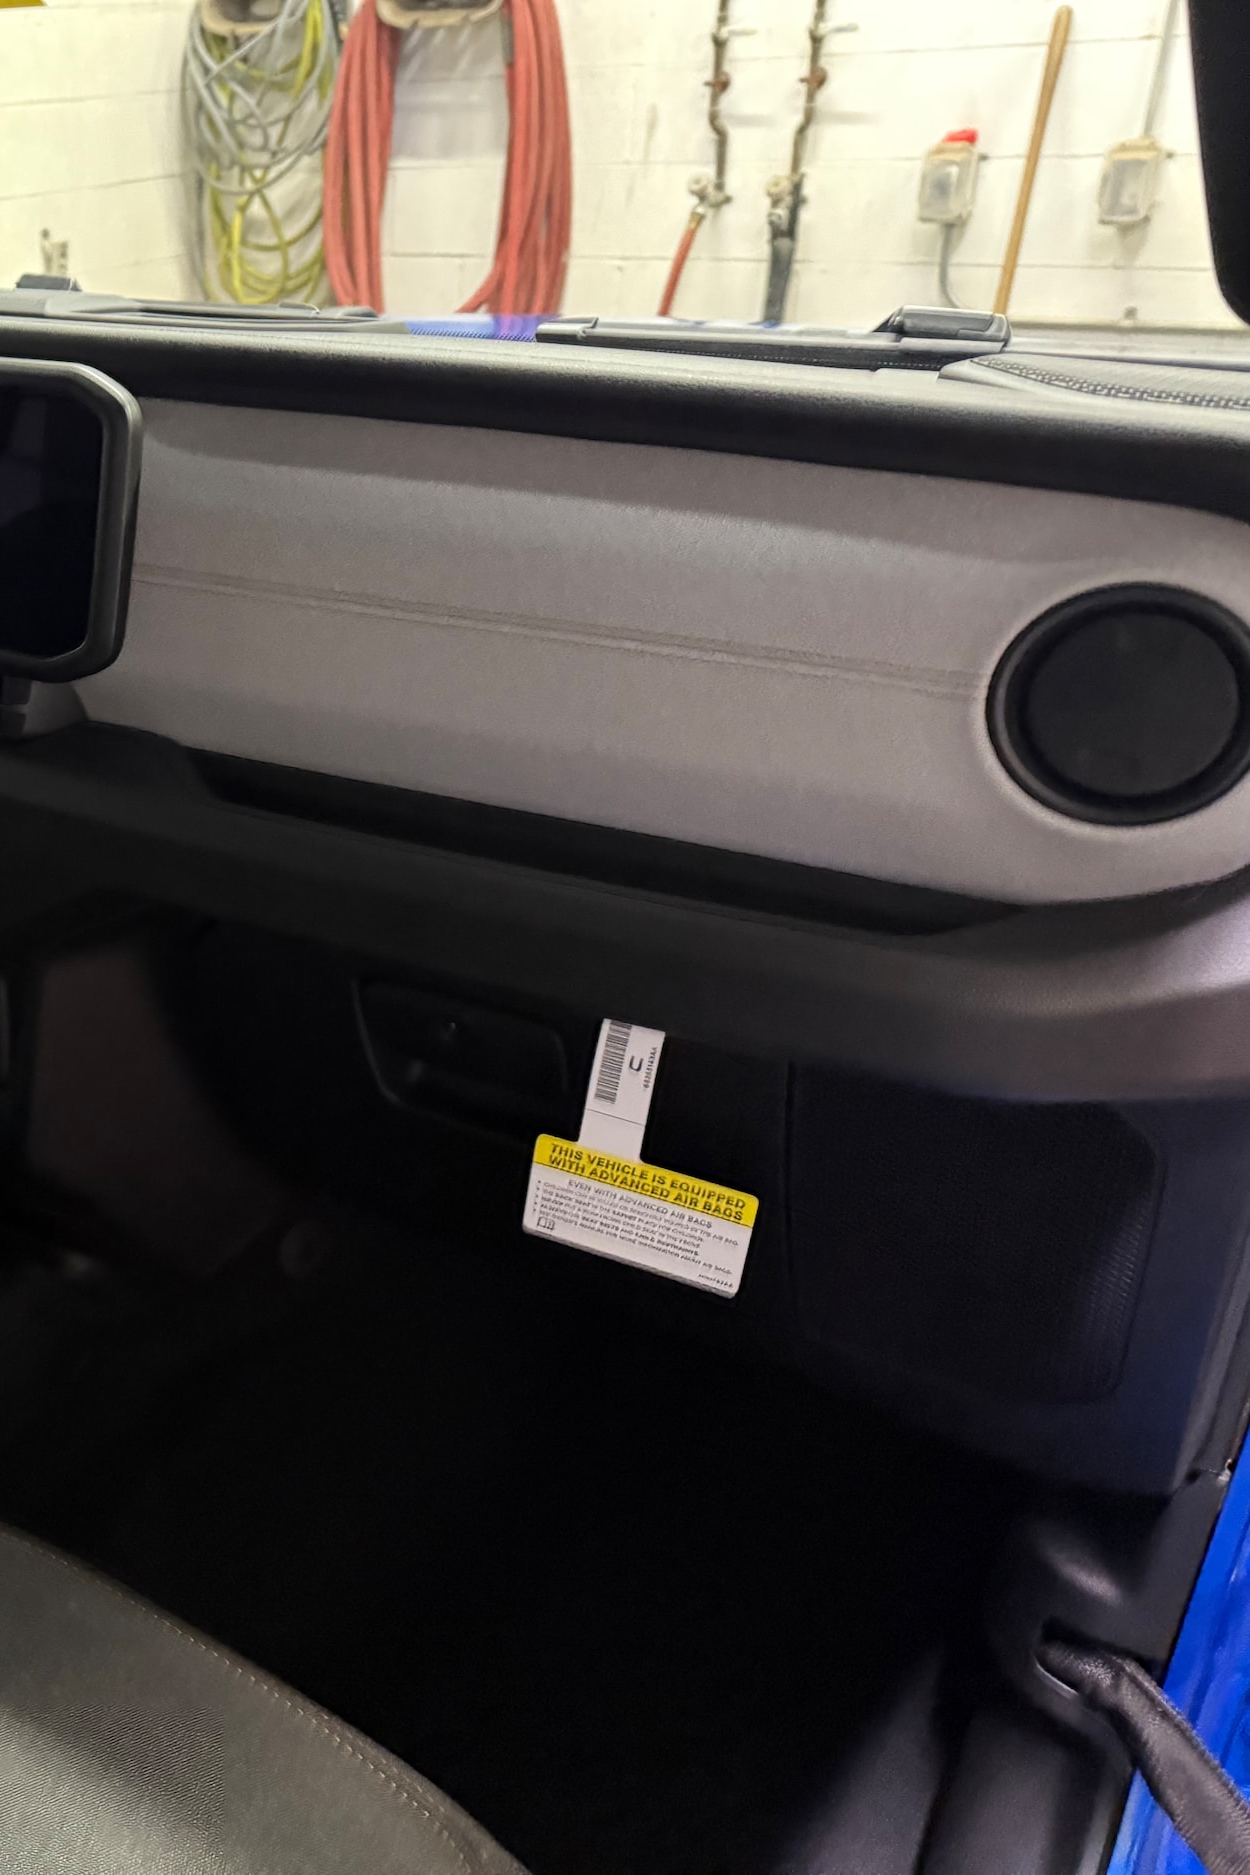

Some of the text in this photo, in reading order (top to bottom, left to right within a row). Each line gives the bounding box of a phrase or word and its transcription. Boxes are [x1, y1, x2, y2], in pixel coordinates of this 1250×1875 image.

[548, 1154, 742, 1221] WITH ADVANCED AIR BAGS
[550, 1143, 745, 1210] THIS VEHICLE IS EQUIPPED
[567, 1178, 592, 1192] EVEN
[593, 1186, 617, 1199] WITH
[618, 1193, 668, 1215] ADVANCED
[669, 1210, 685, 1220] AIR
[686, 1215, 713, 1229] BAGS
